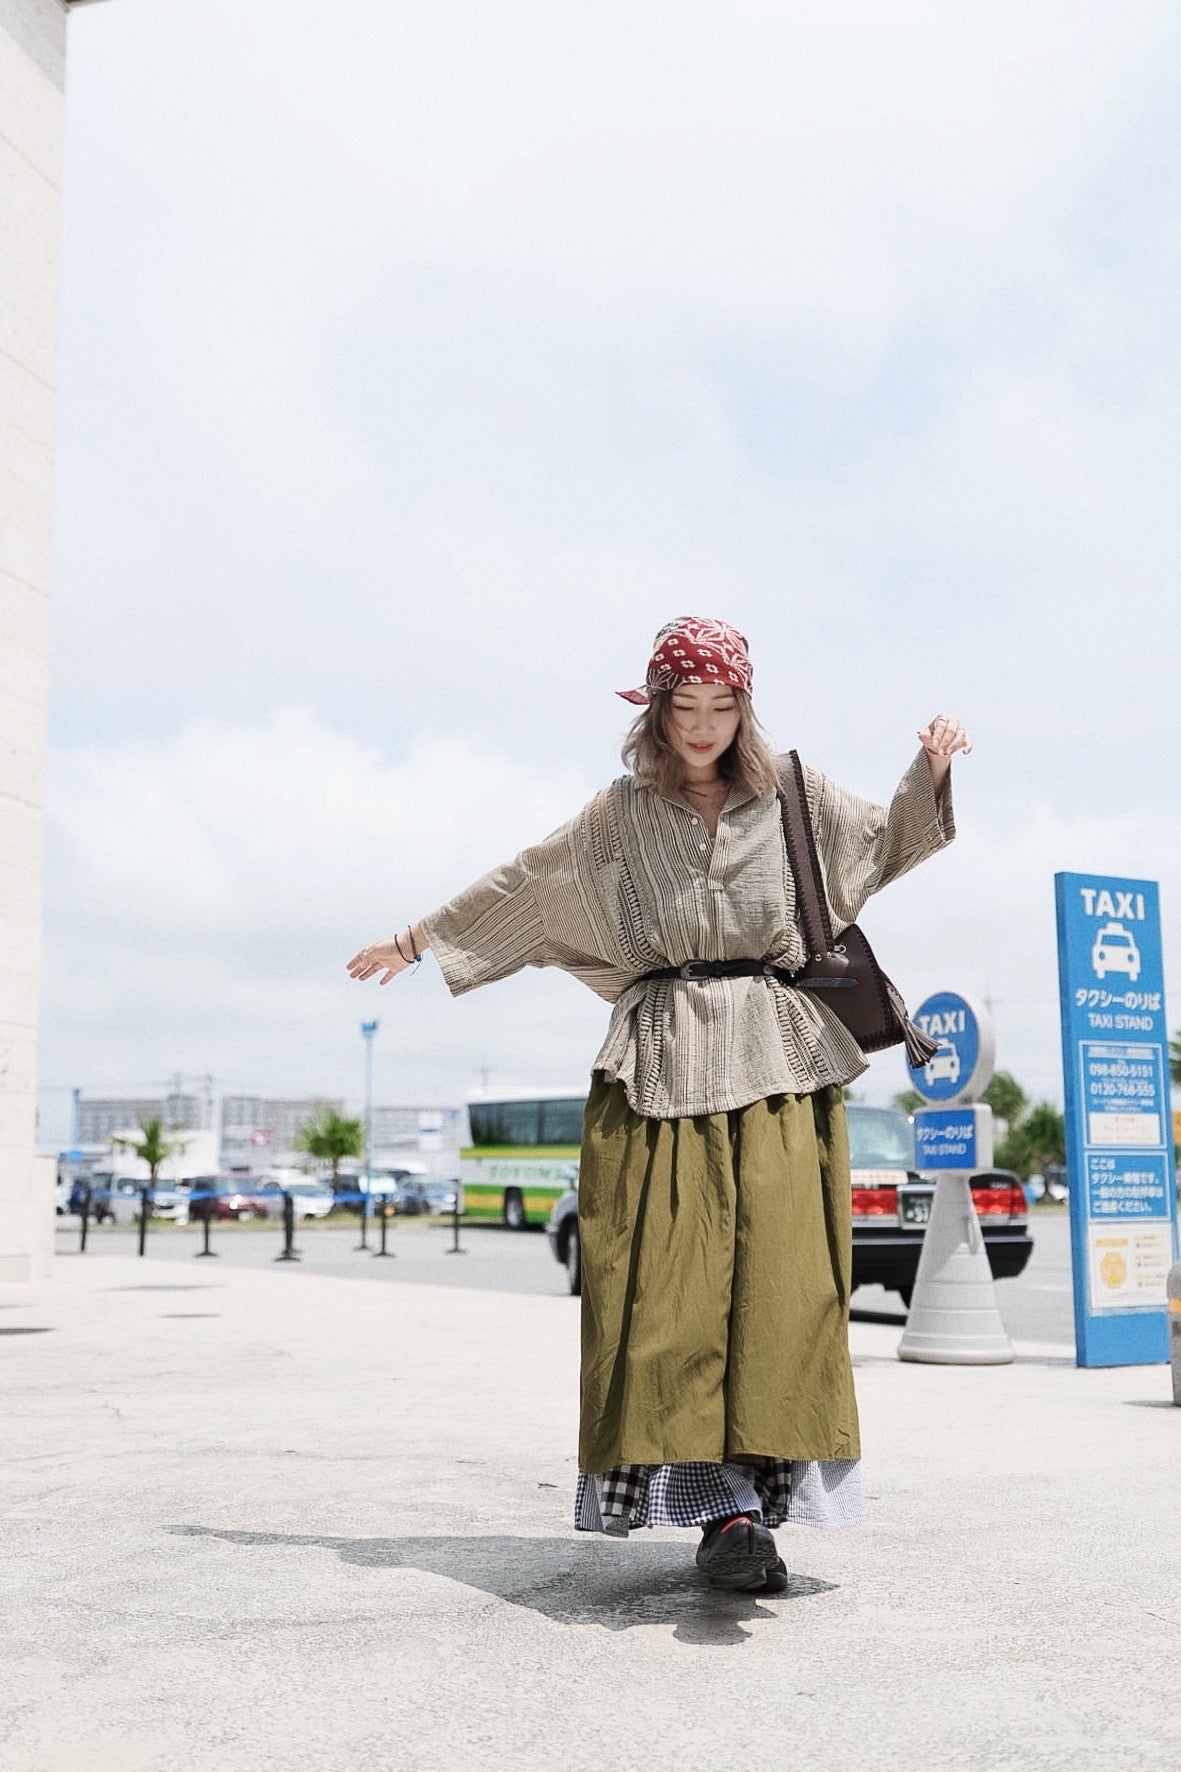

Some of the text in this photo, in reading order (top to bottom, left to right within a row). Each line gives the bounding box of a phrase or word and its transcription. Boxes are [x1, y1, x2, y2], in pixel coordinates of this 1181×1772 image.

[1080, 888, 1145, 920] TAXI
[1076, 988, 1161, 1011] タクシーのりば
[919, 1009, 966, 1036] TAXI
[1088, 1012, 1153, 1031] TAXI STAND
[917, 1124, 973, 1141] タクシーのりば
